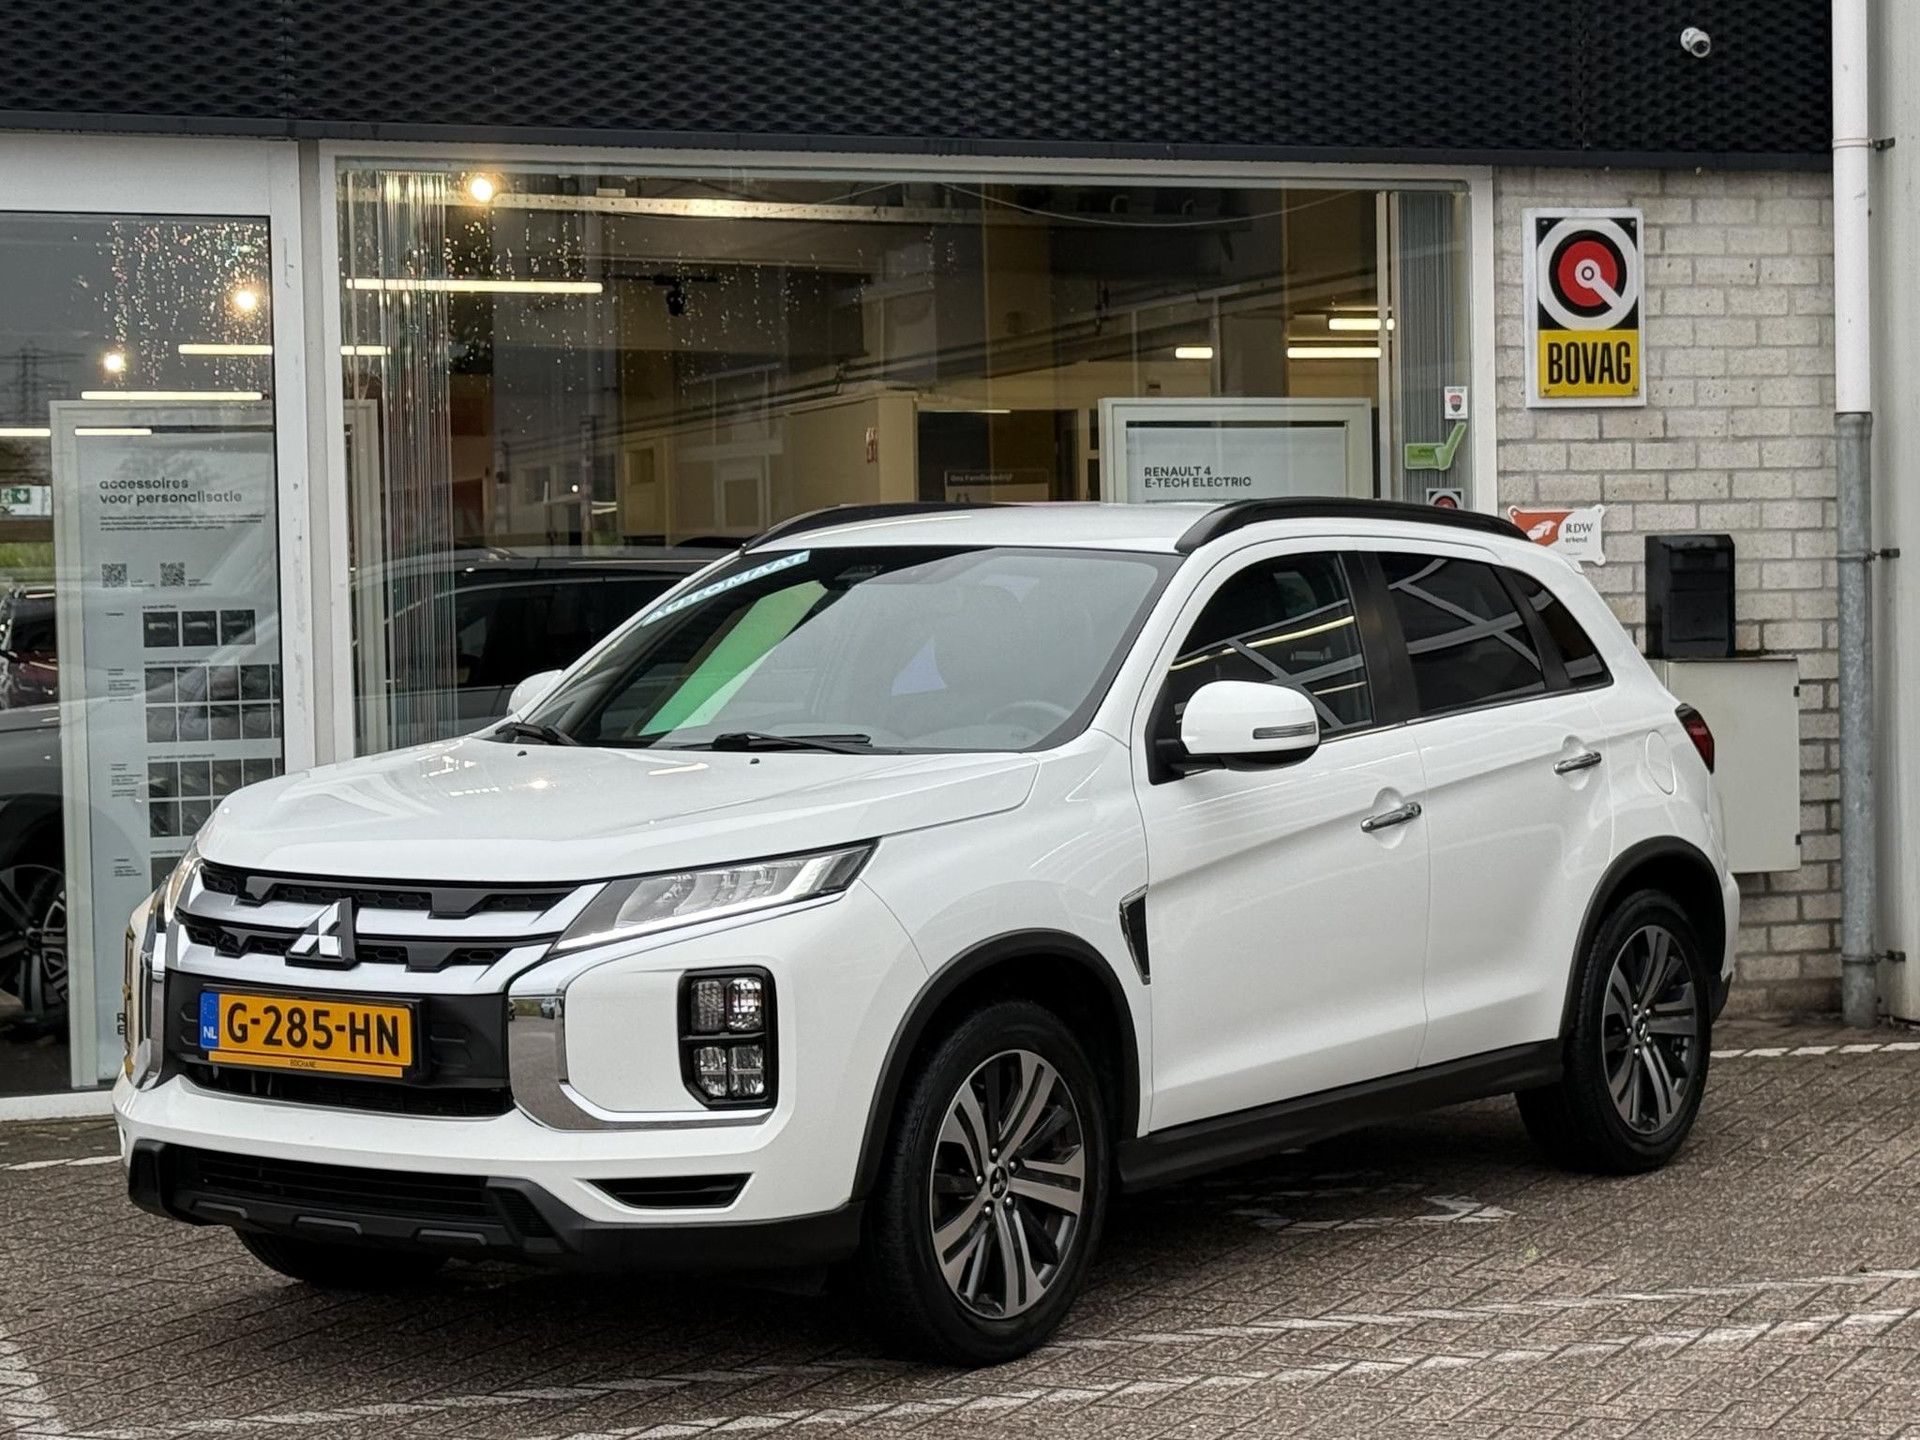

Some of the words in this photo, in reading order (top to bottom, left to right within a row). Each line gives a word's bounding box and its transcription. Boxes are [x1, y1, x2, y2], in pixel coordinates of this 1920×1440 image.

[1547, 341, 1631, 385] BOVAG
[1144, 466, 1201, 477] RENAULT
[1203, 466, 1212, 475] 4
[100, 477, 189, 490] accessoires
[1145, 478, 1189, 488] E-TECH
[1192, 477, 1252, 487] ELECTRIC
[100, 493, 133, 504] voor
[137, 491, 243, 506] personalisatie
[1565, 523, 1593, 534] RDW
[645, 552, 809, 621] AUTOMAAT
[203, 1026, 217, 1039] NL
[227, 1002, 399, 1057] G-285-HN
